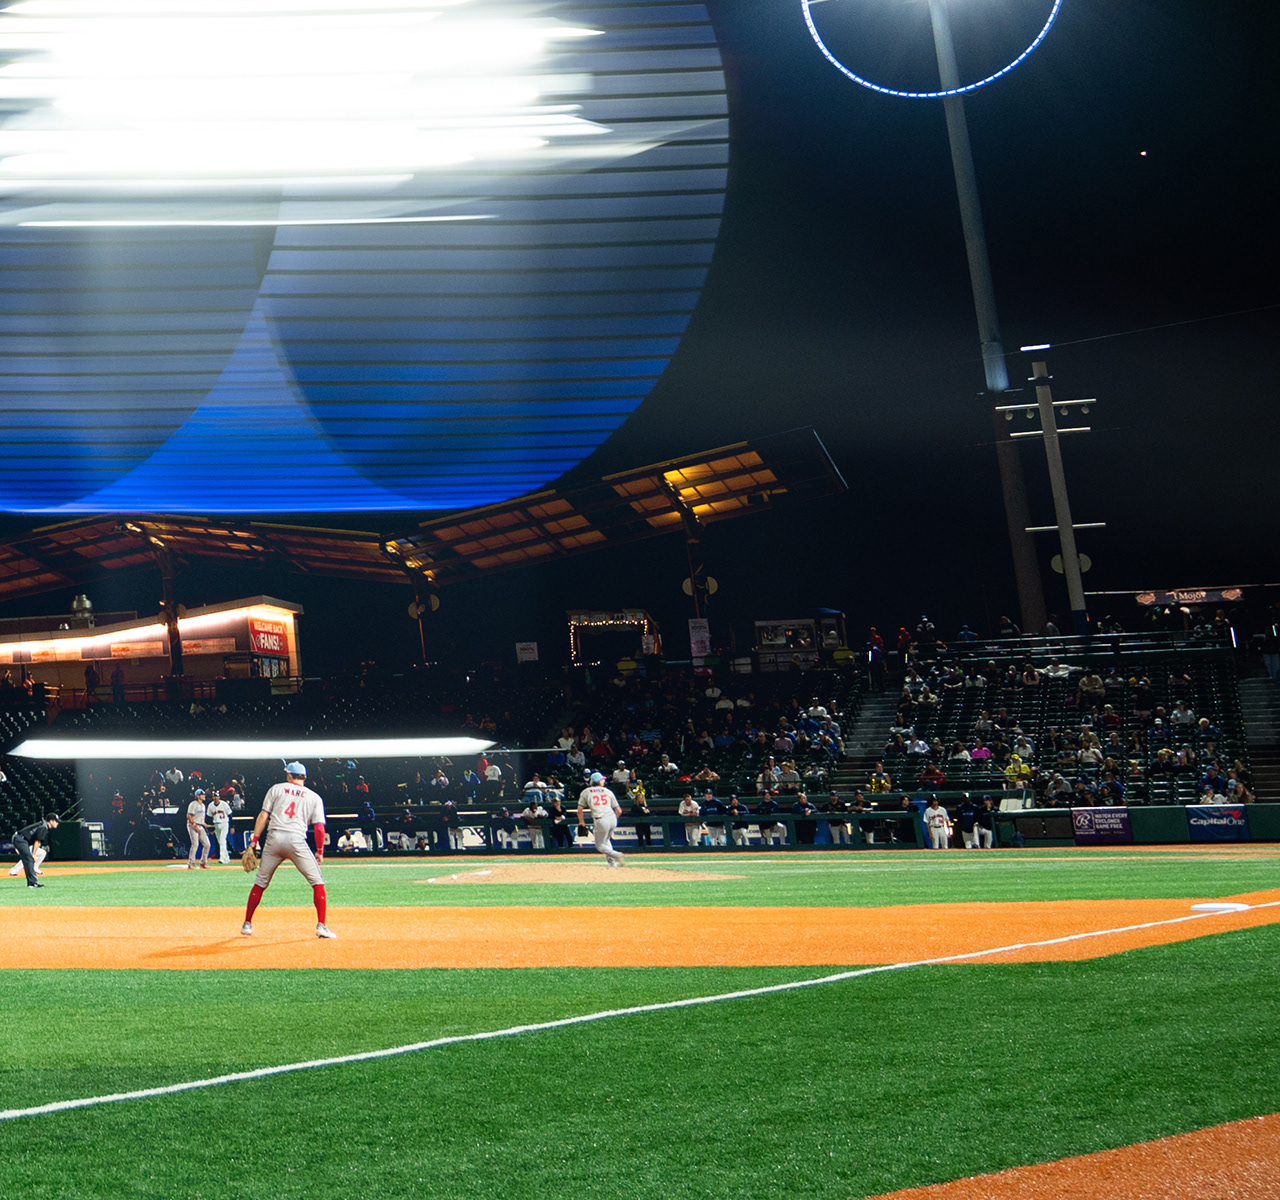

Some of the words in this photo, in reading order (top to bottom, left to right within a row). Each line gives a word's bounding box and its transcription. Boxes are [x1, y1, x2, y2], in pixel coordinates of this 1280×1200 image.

[254, 621, 272, 632] WELCOME
[273, 624, 283, 634] BACK
[260, 633, 280, 651] FANS!
[284, 788, 306, 798] WARE
[592, 794, 608, 806] 25
[284, 801, 296, 819] 4
